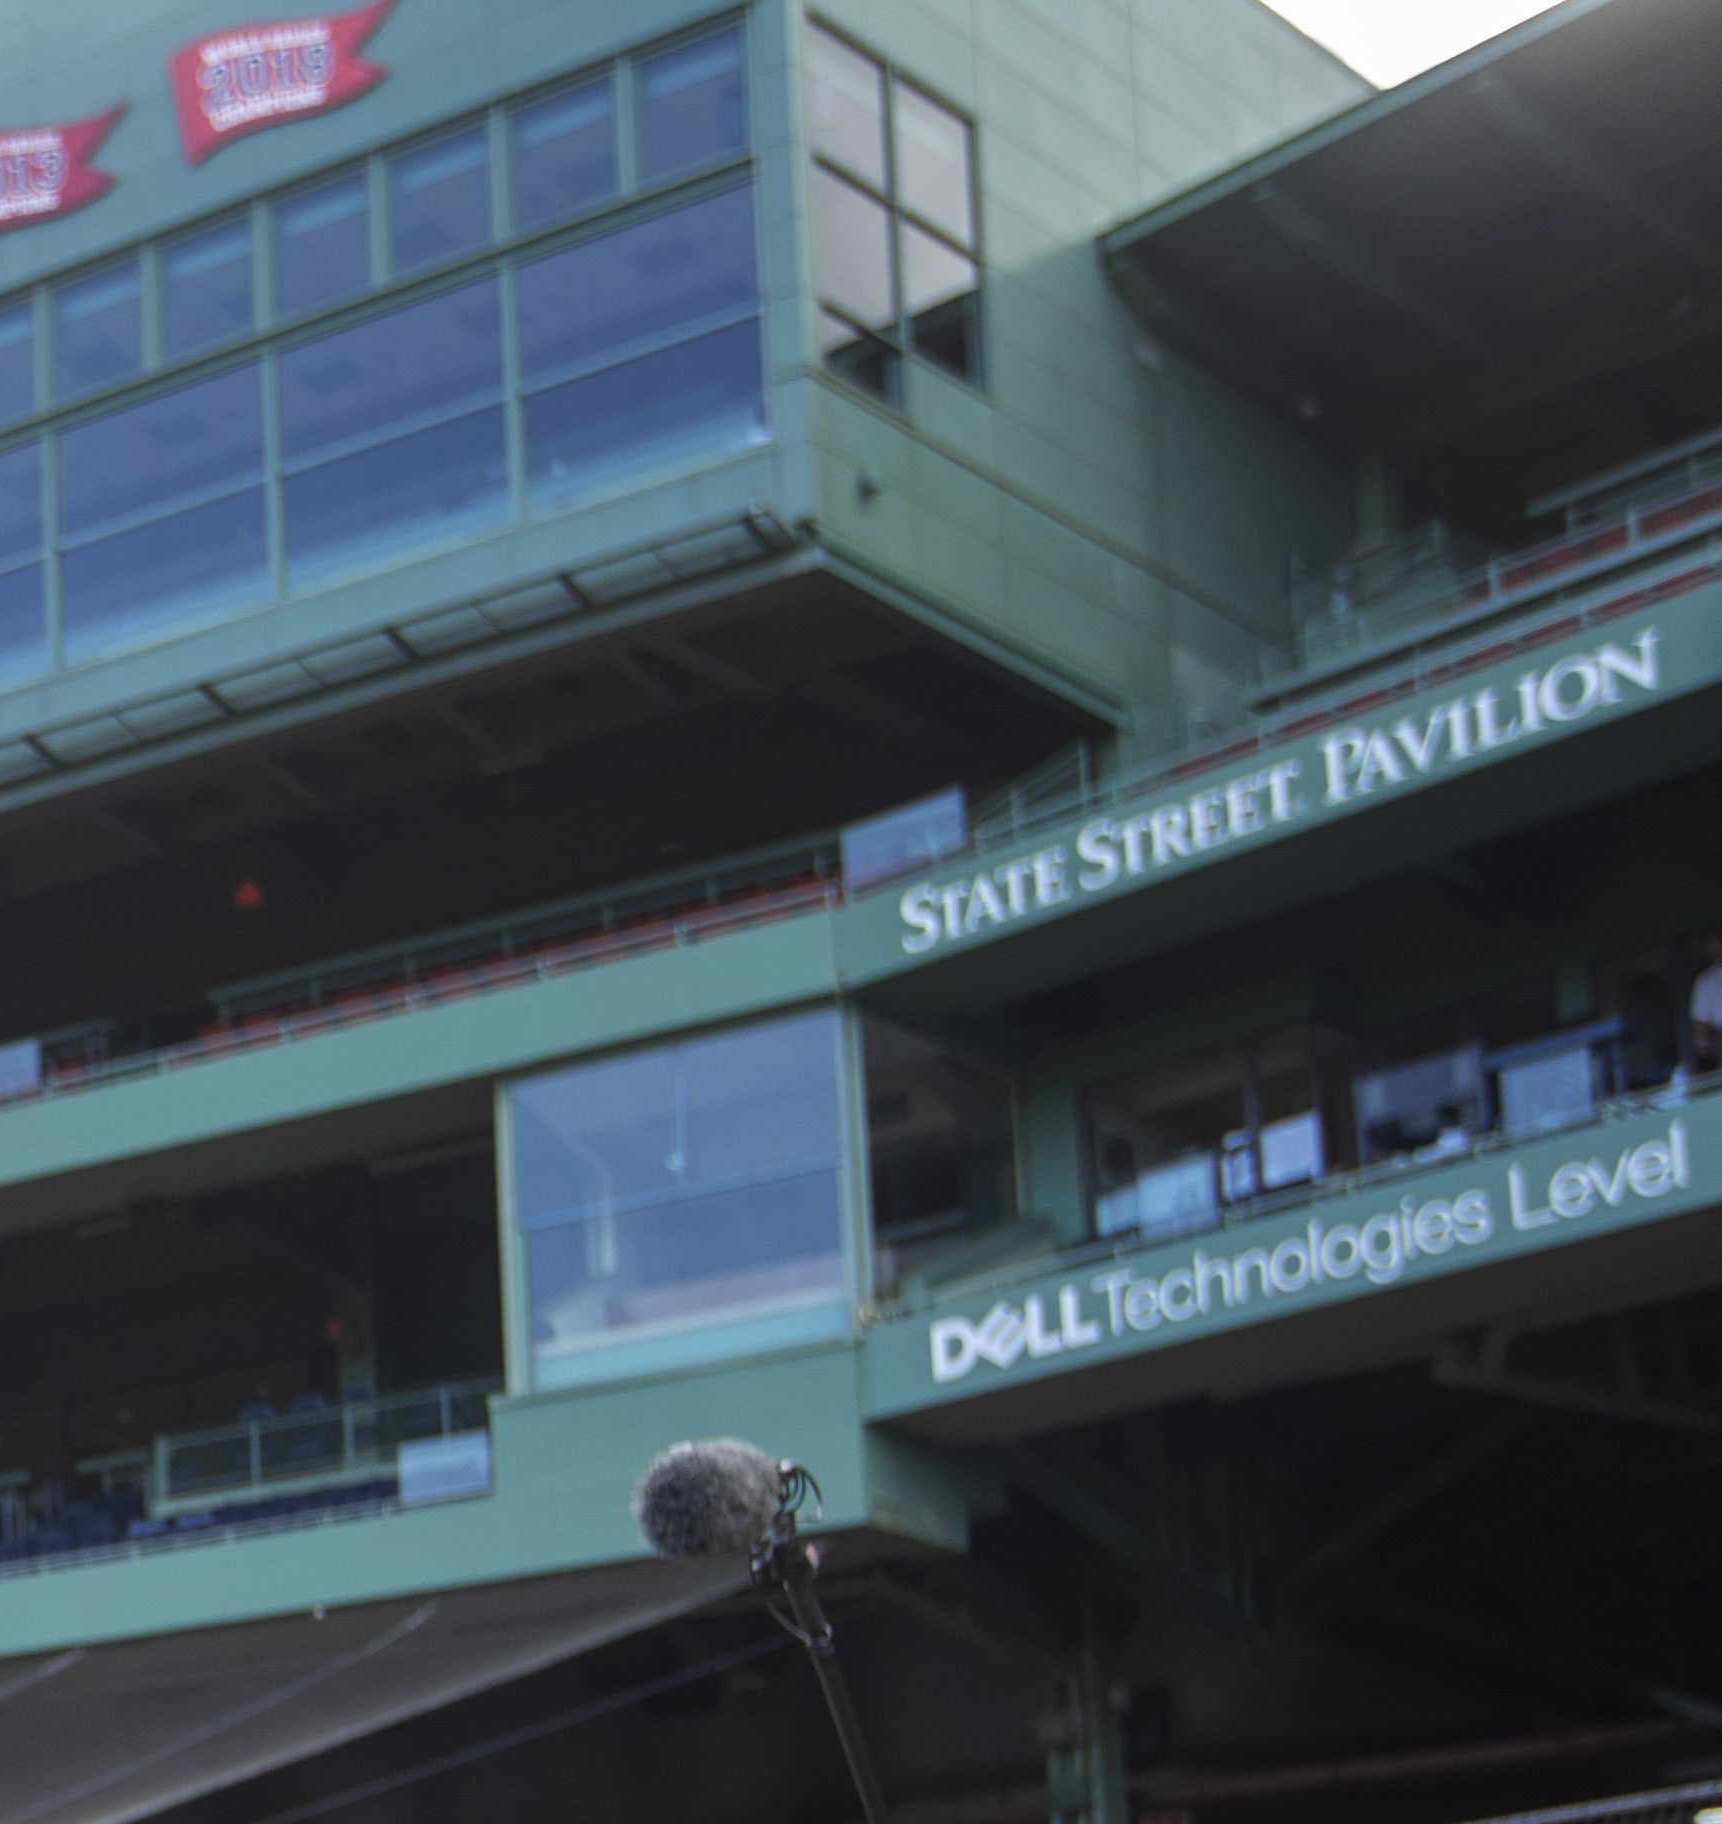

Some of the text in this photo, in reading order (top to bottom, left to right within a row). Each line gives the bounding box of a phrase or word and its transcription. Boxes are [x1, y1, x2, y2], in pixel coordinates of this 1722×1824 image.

[196, 43, 336, 116] 2018
[899, 627, 1661, 955] STATE STREET PAVILION
[929, 1118, 1689, 1383] DELL Technologies Level
